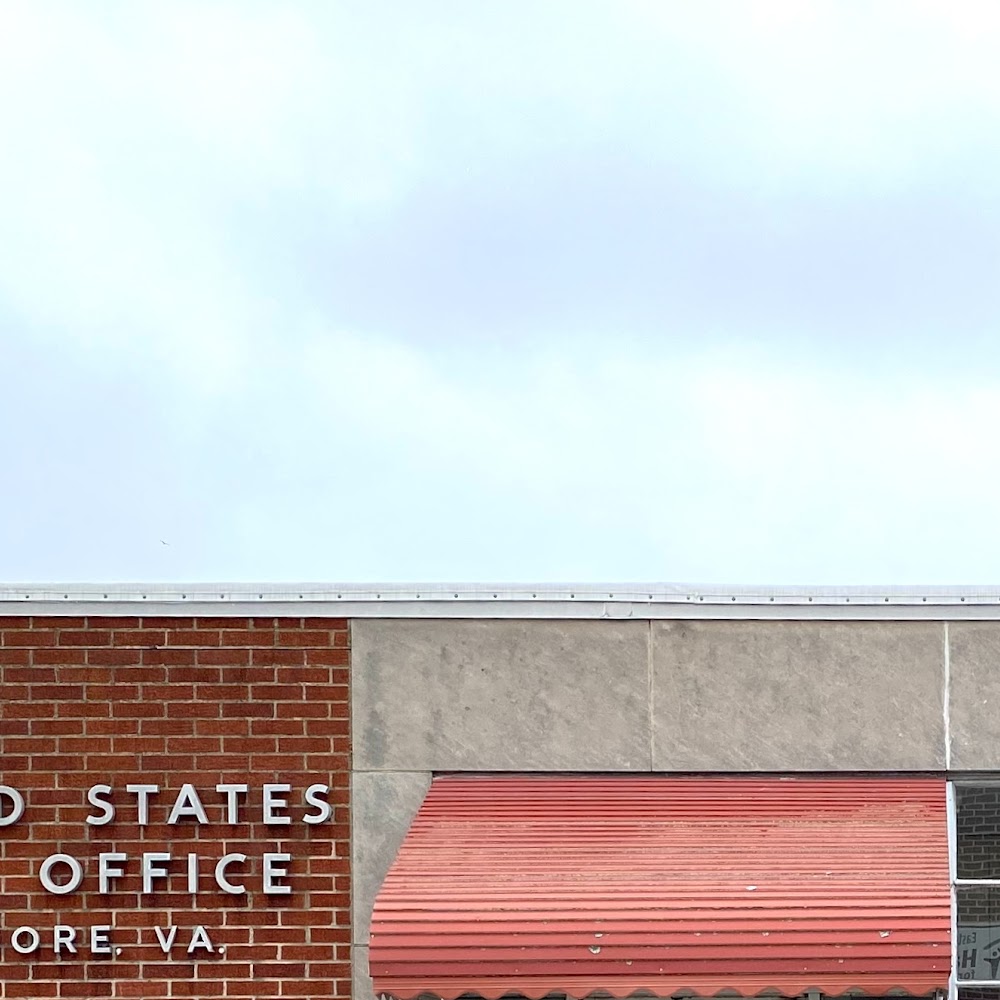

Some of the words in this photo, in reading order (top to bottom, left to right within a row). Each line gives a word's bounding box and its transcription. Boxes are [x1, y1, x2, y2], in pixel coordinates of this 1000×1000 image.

[86, 784, 333, 826] STATES
[39, 853, 292, 895] OFFICE
[154, 925, 225, 954] VA.
